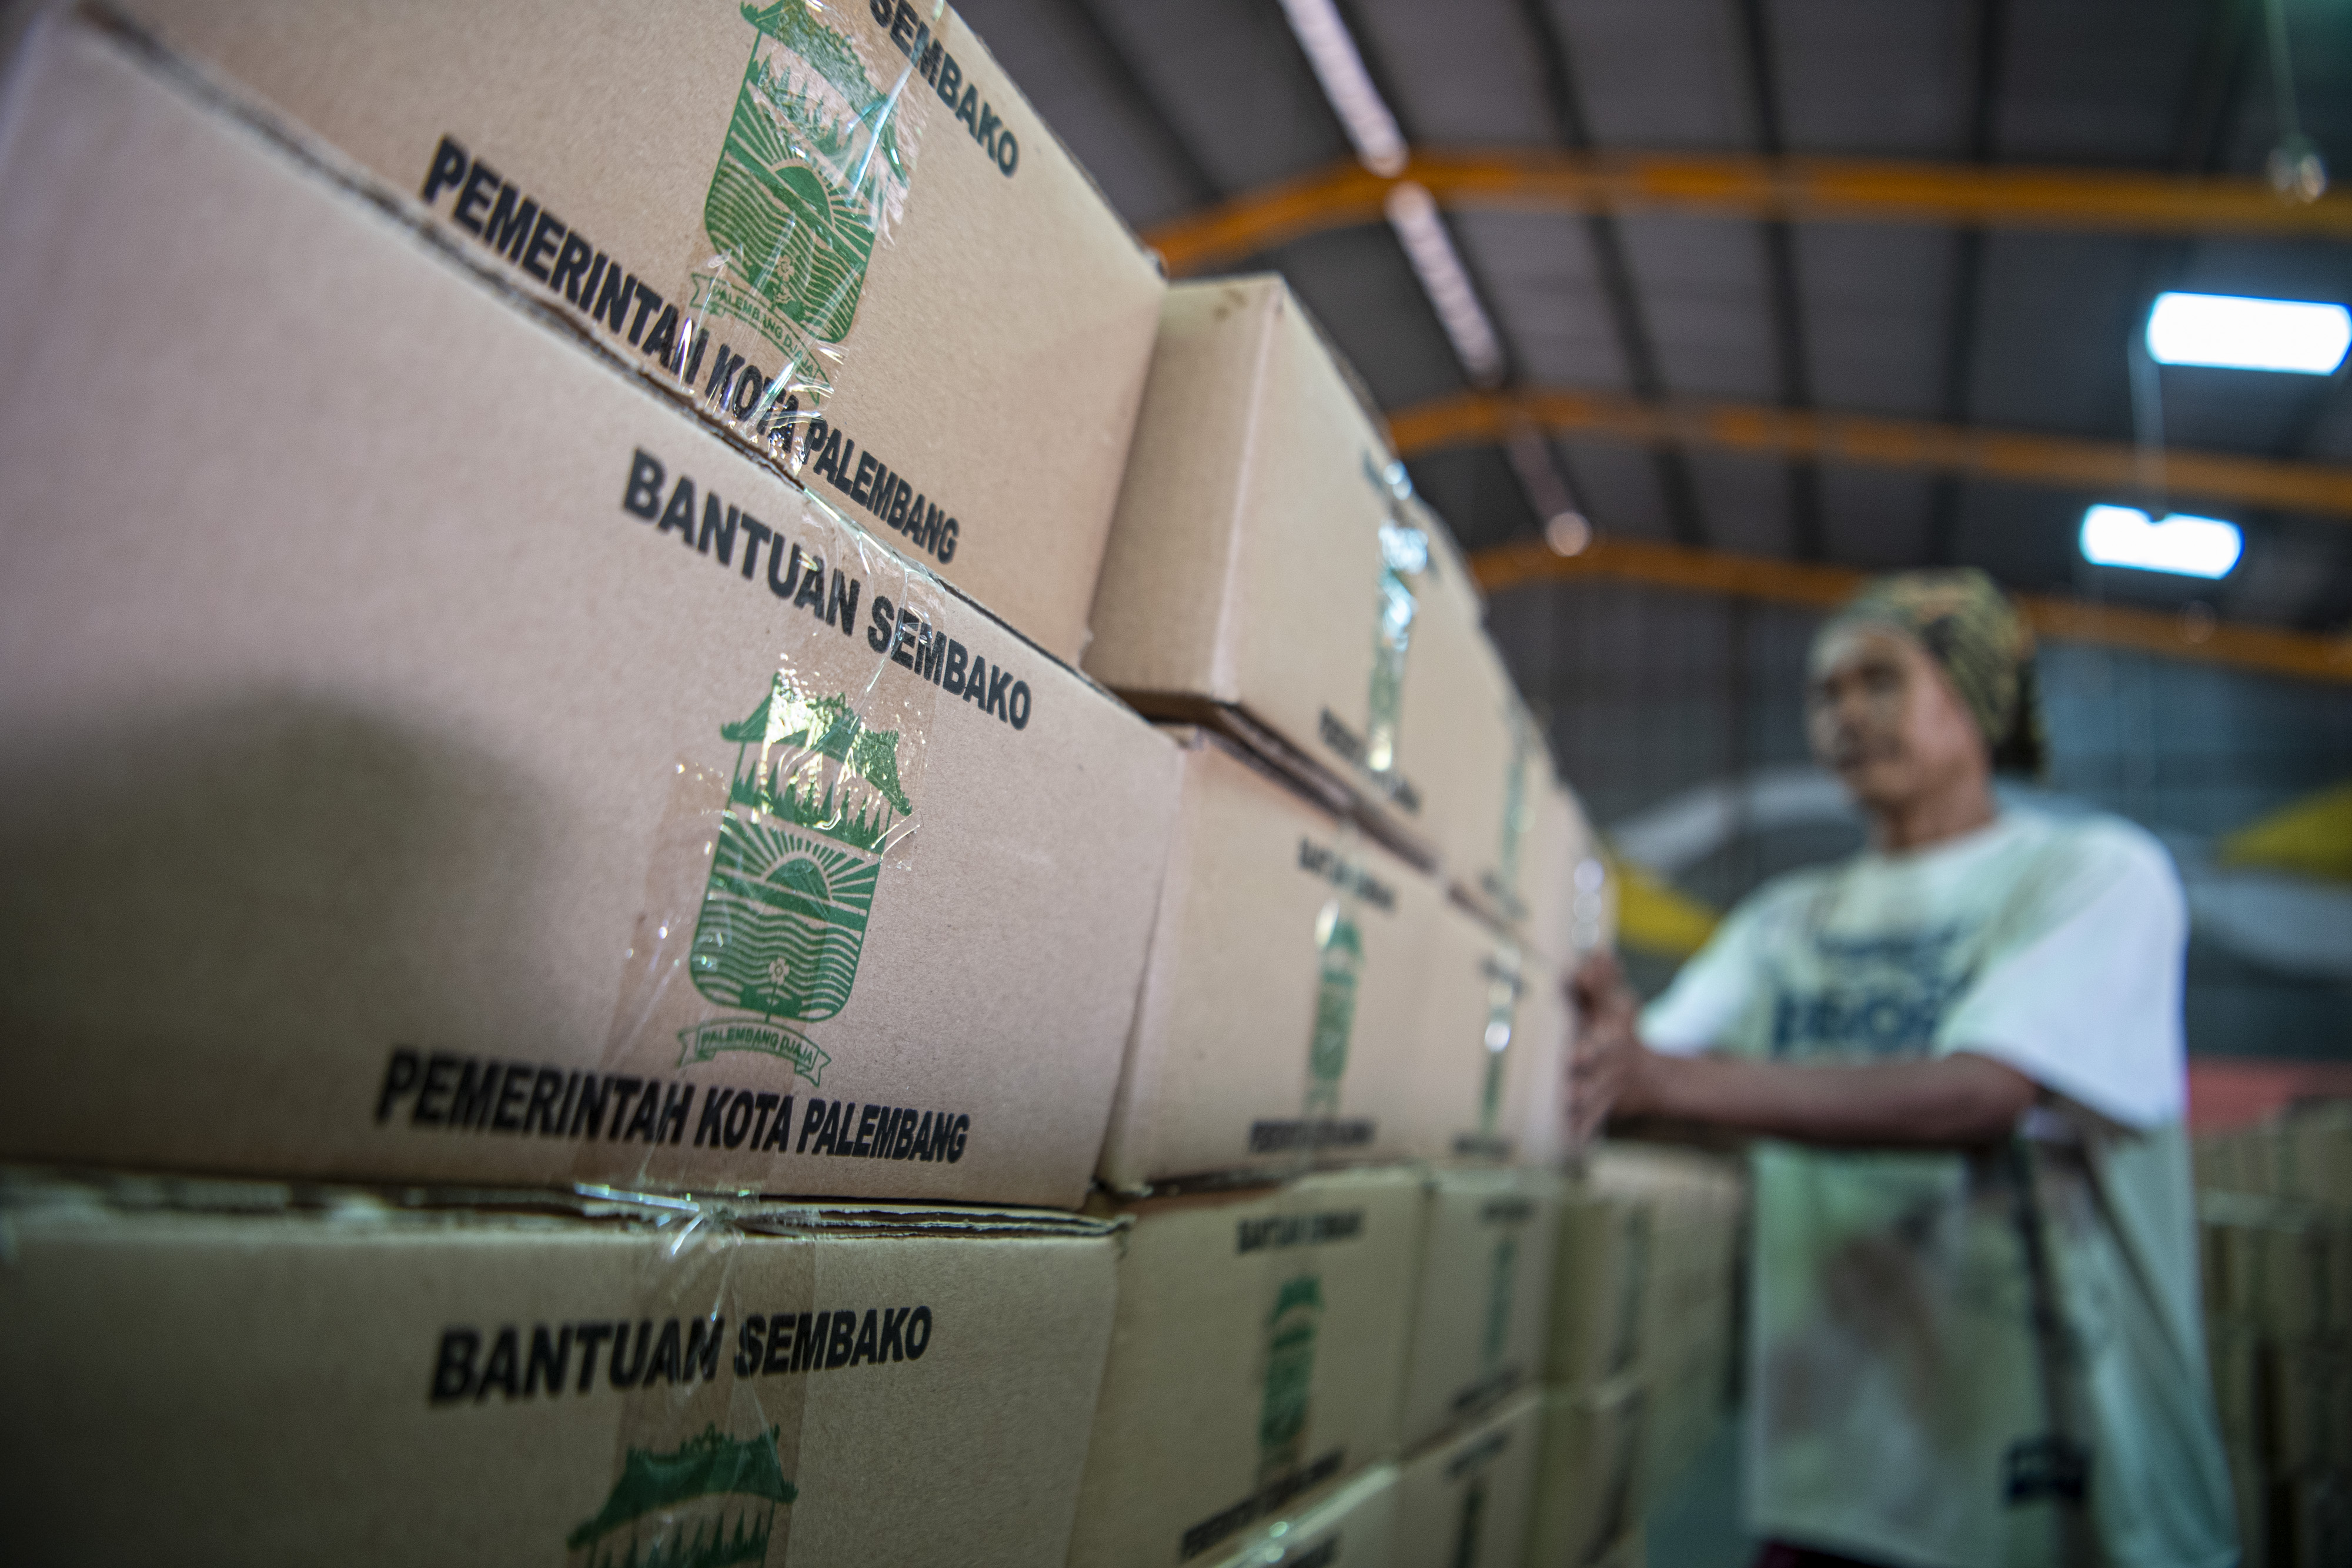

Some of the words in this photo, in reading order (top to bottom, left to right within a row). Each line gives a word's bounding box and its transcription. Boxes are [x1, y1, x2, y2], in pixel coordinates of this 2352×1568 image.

[420, 133, 710, 386] PEMERINTAH
[800, 416, 960, 564] PALEMBANG
[711, 285, 784, 340] PALEMBANG
[622, 447, 860, 637] BANTUAN
[867, 595, 1032, 731] SEMBAKO
[701, 1028, 780, 1049] PALEMBANG
[376, 1049, 696, 1144] PEMERINTAH
[694, 1085, 796, 1154] KOTA
[796, 1098, 971, 1164] PALEMBANG
[427, 1317, 723, 1405] BANTUAN
[733, 1305, 933, 1378] SEMBAKO
